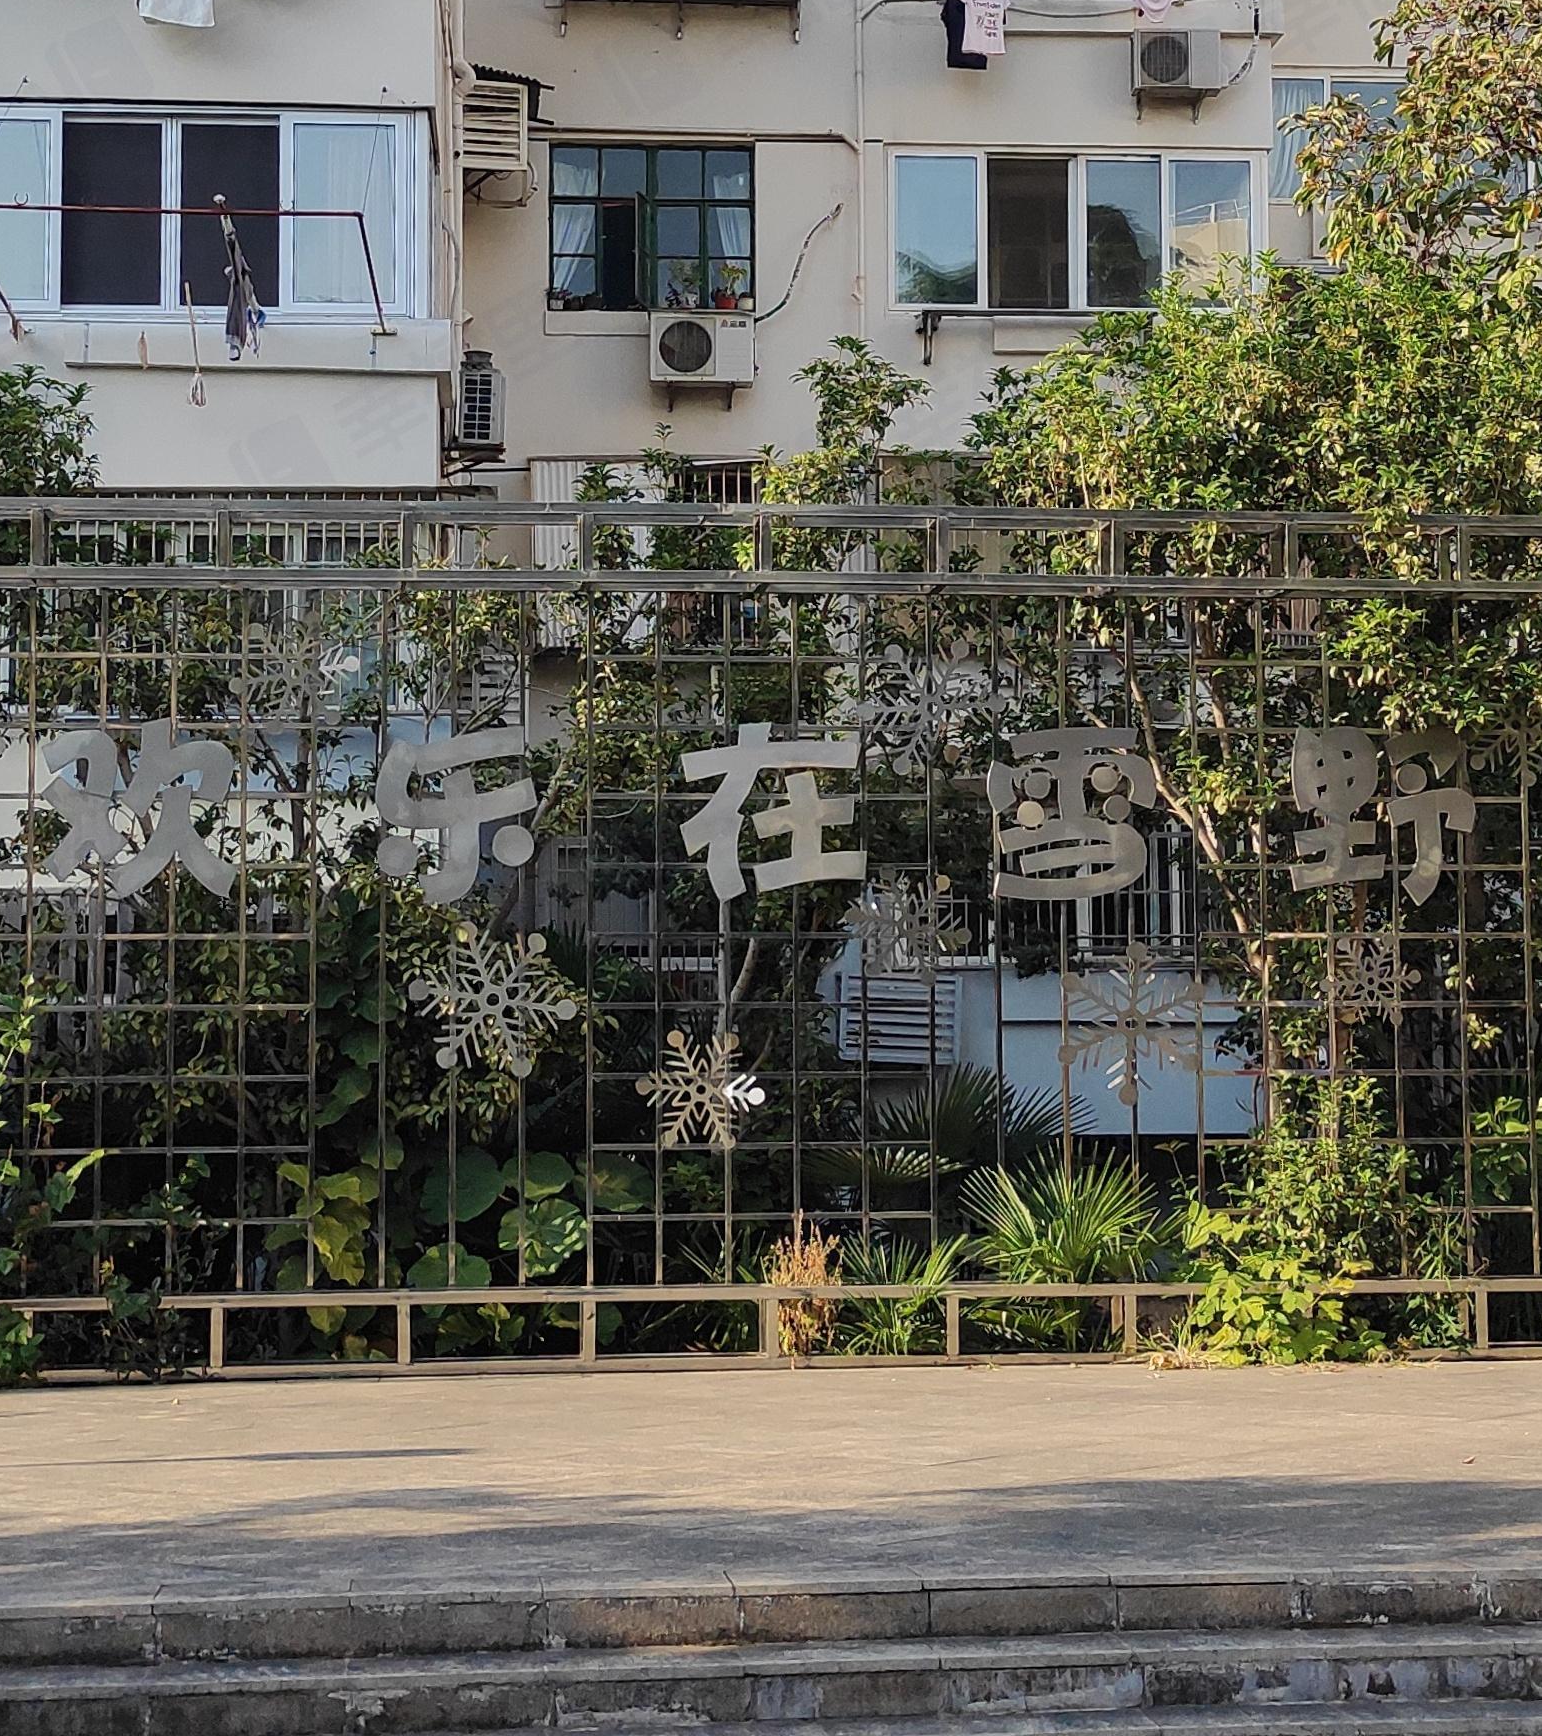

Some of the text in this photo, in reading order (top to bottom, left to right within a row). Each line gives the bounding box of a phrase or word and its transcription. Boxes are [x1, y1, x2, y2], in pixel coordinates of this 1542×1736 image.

[42, 717, 1476, 905] 欢乐在雪野
